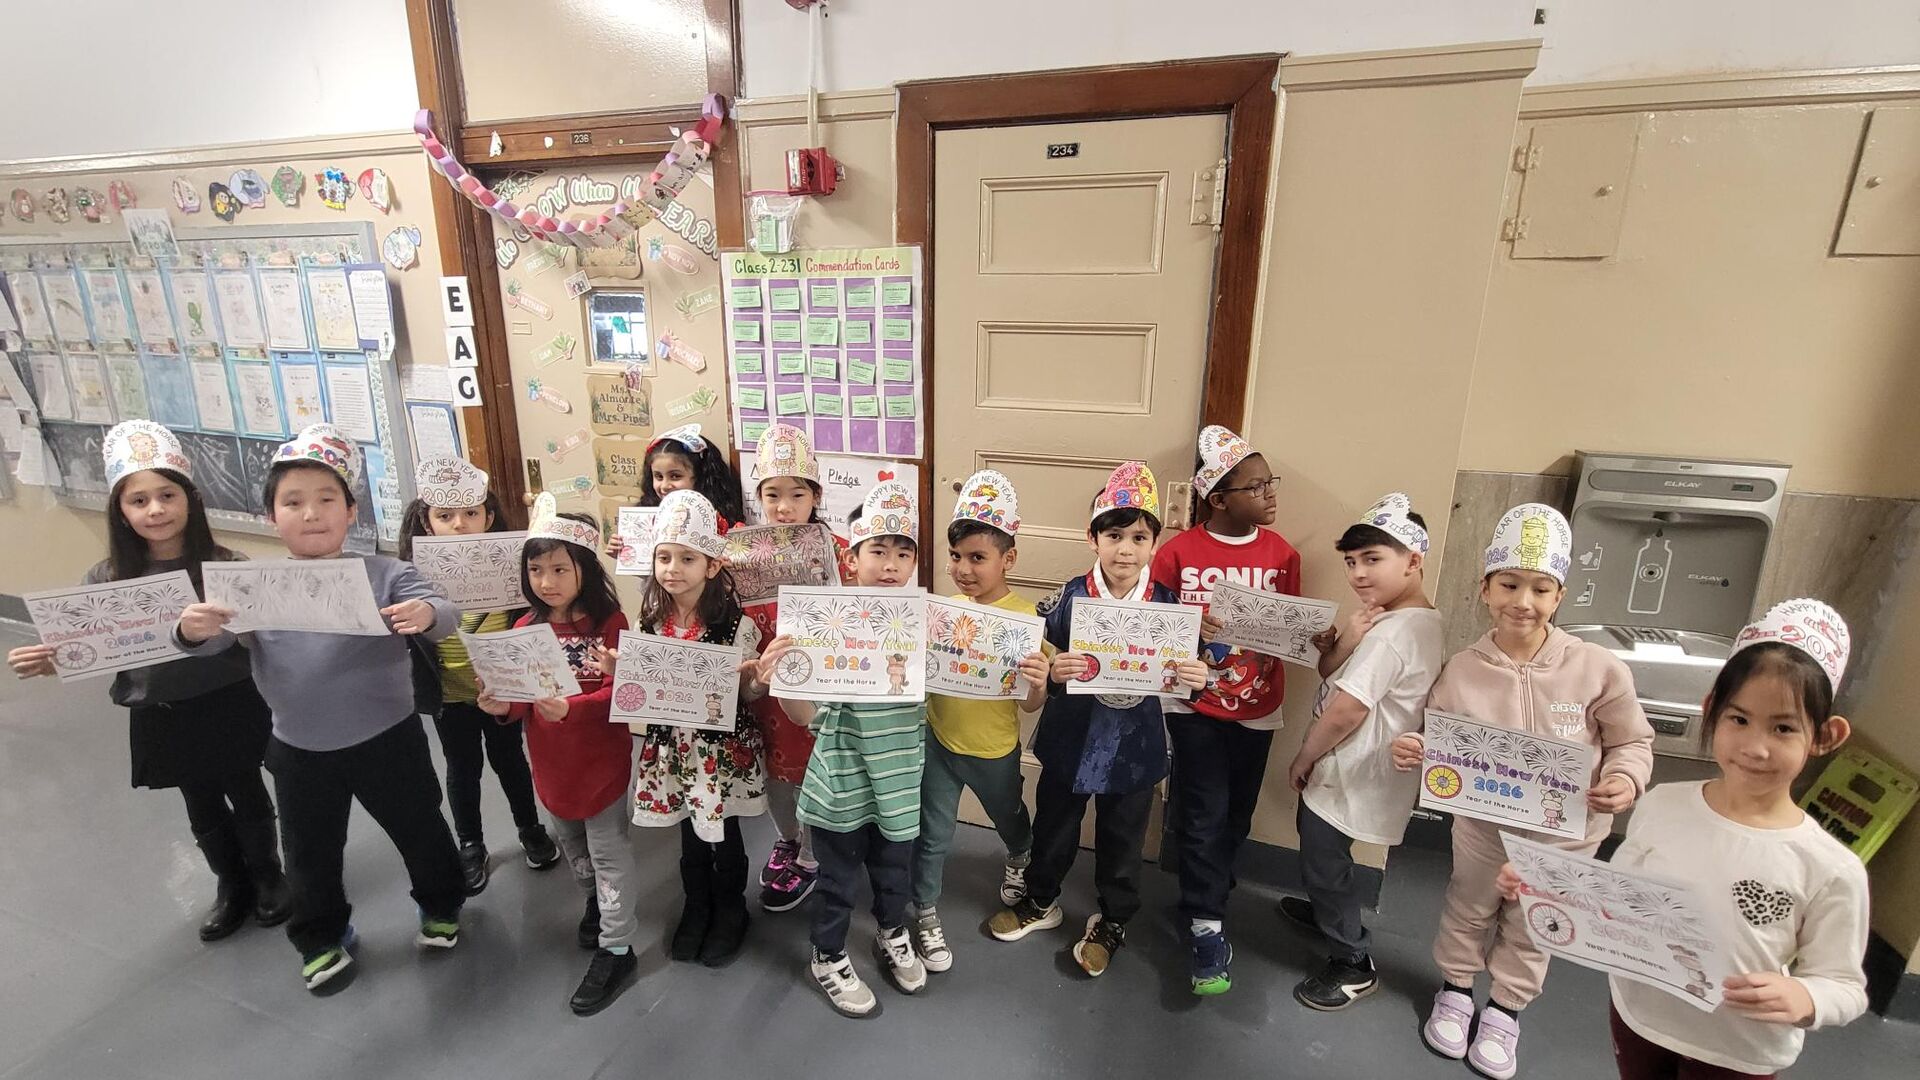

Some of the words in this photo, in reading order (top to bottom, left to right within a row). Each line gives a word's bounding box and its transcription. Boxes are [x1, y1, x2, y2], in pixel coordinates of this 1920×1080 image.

[1052, 145, 1074, 156] 234
[571, 174, 615, 203] When
[735, 258, 768, 274] Class
[769, 258, 802, 273] 2-231
[806, 257, 873, 273] Commendation
[875, 255, 900, 271] Cards
[780, 428, 796, 436] THE
[419, 460, 434, 479] HAPPY
[436, 459, 457, 468] NEW
[460, 462, 478, 480] YEAR
[610, 454, 637, 466] Class
[611, 465, 637, 475] 2-231
[828, 468, 860, 488] Pledge
[982, 475, 1000, 485] NEW
[1001, 484, 1014, 503] YEAR
[1663, 480, 1702, 488] ELKAY
[422, 487, 476, 506] 2026
[867, 485, 889, 507] HAPPY
[890, 484, 909, 494] NEW
[681, 495, 697, 506] THE
[695, 503, 712, 529] HORSE
[956, 501, 1006, 526] 2026
[1495, 516, 1512, 541] YEAR
[1513, 507, 1527, 519] OF
[1530, 506, 1553, 520] THE
[1552, 517, 1569, 549] HORSE
[688, 531, 725, 556] 2026
[1180, 566, 1280, 592] SONIC
[1688, 573, 1722, 581] ELKAY
[1182, 593, 1206, 601] THE
[1779, 603, 1817, 616] HAPPY
[1822, 609, 1847, 637] NEW
[104, 631, 156, 650] 2026
[790, 635, 840, 648] inese
[844, 636, 879, 650] New
[1071, 639, 1125, 655] Chinese
[1127, 644, 1157, 657] New
[1161, 647, 1191, 660] Year
[823, 654, 872, 672] 2026
[967, 648, 998, 664] New
[949, 660, 989, 679] 2026
[1109, 659, 1150, 673] 2026
[619, 669, 670, 684] Chinese
[672, 677, 701, 690] New
[843, 677, 855, 685] the
[941, 676, 954, 684] Year
[973, 682, 991, 690] Horse
[655, 688, 694, 704] 2026
[1424, 748, 1491, 773] Chinese
[1495, 762, 1534, 782] New
[1538, 772, 1581, 795] Year
[1473, 776, 1525, 800] 2026
[1465, 795, 1481, 803] Year
[1493, 801, 1506, 809] the
[1506, 804, 1530, 814] Horse
[1817, 787, 1875, 829] CAUTION
